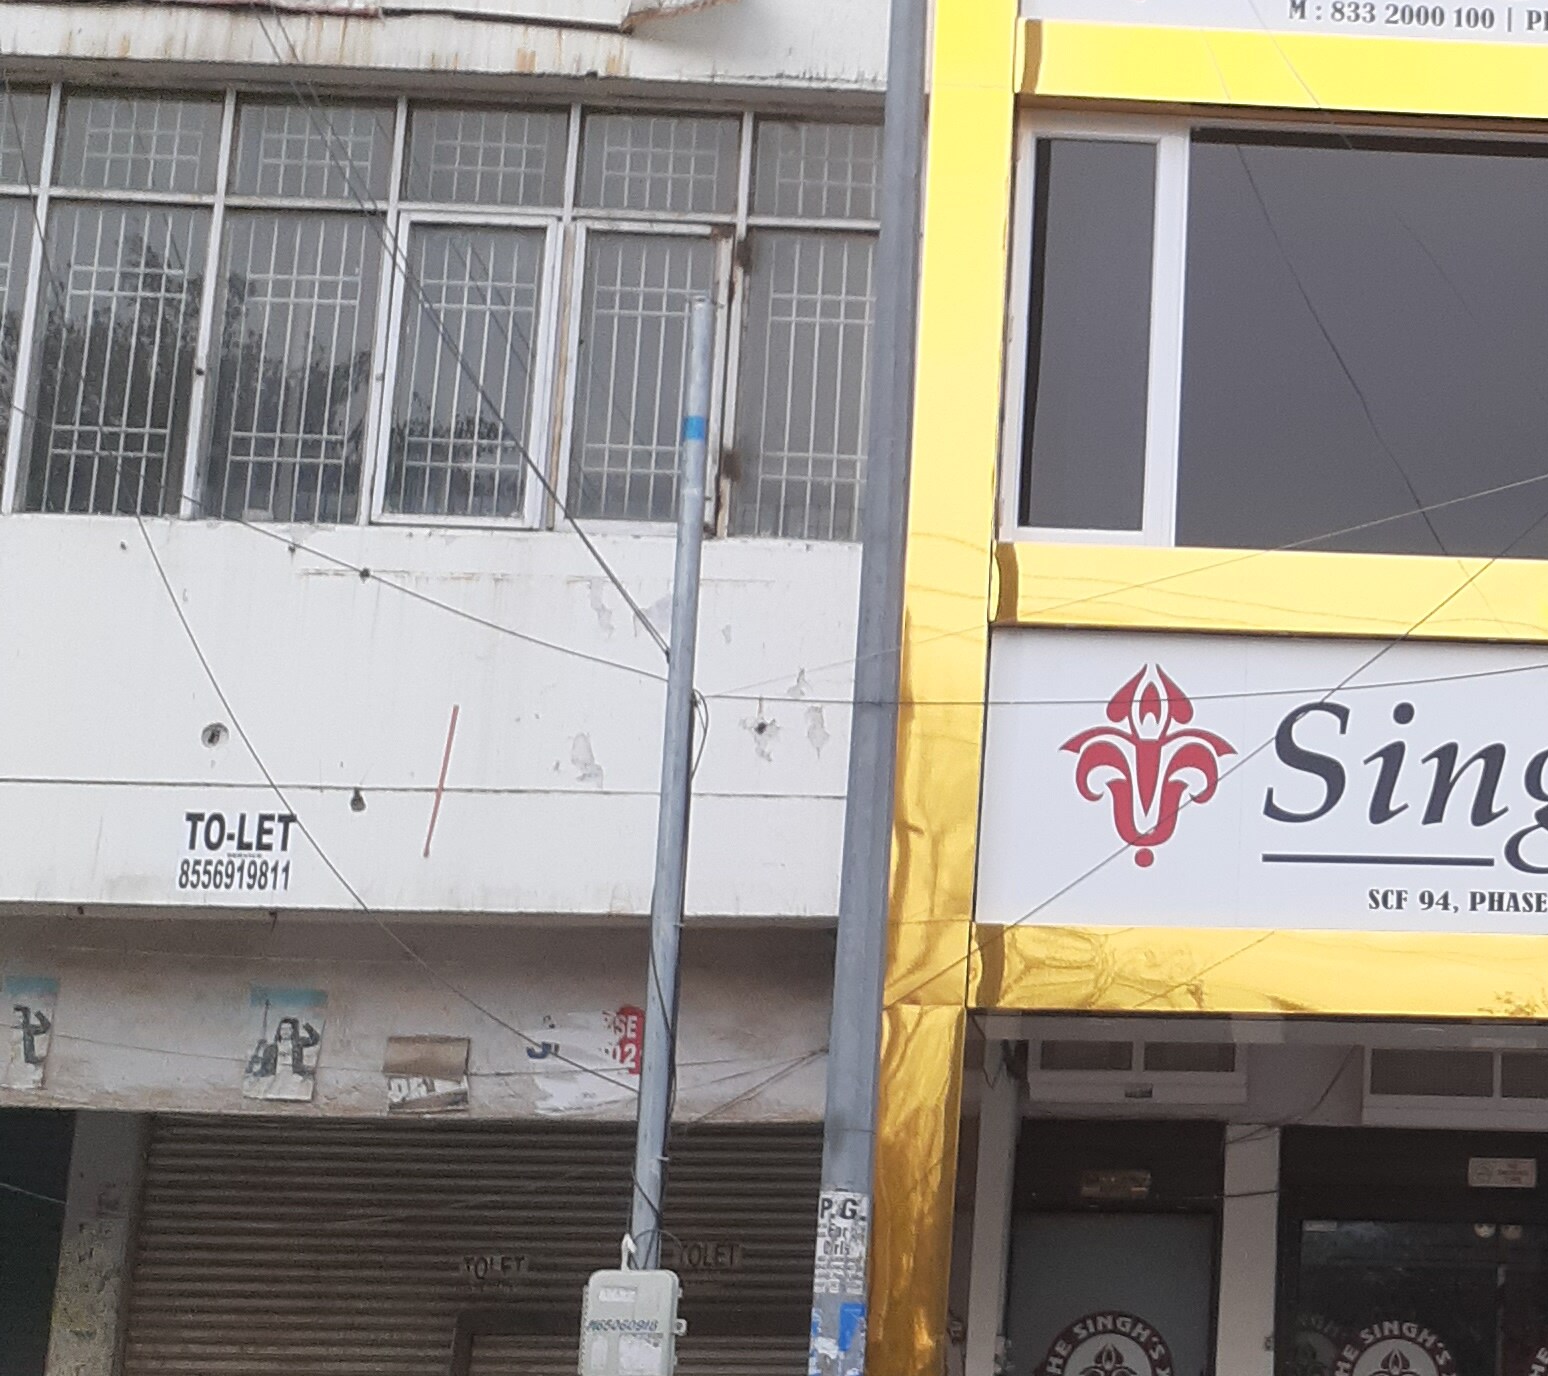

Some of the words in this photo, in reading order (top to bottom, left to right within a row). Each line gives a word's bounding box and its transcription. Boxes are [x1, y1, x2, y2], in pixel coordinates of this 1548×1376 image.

[1330, 0, 1377, 24] 833
[1385, 3, 1445, 28] 2000
[1453, 6, 1496, 30] 100
[185, 812, 298, 851] TO-LET
[178, 858, 291, 891] 8556919811
[1368, 888, 1408, 912] SCF
[1418, 889, 1459, 915] 94,
